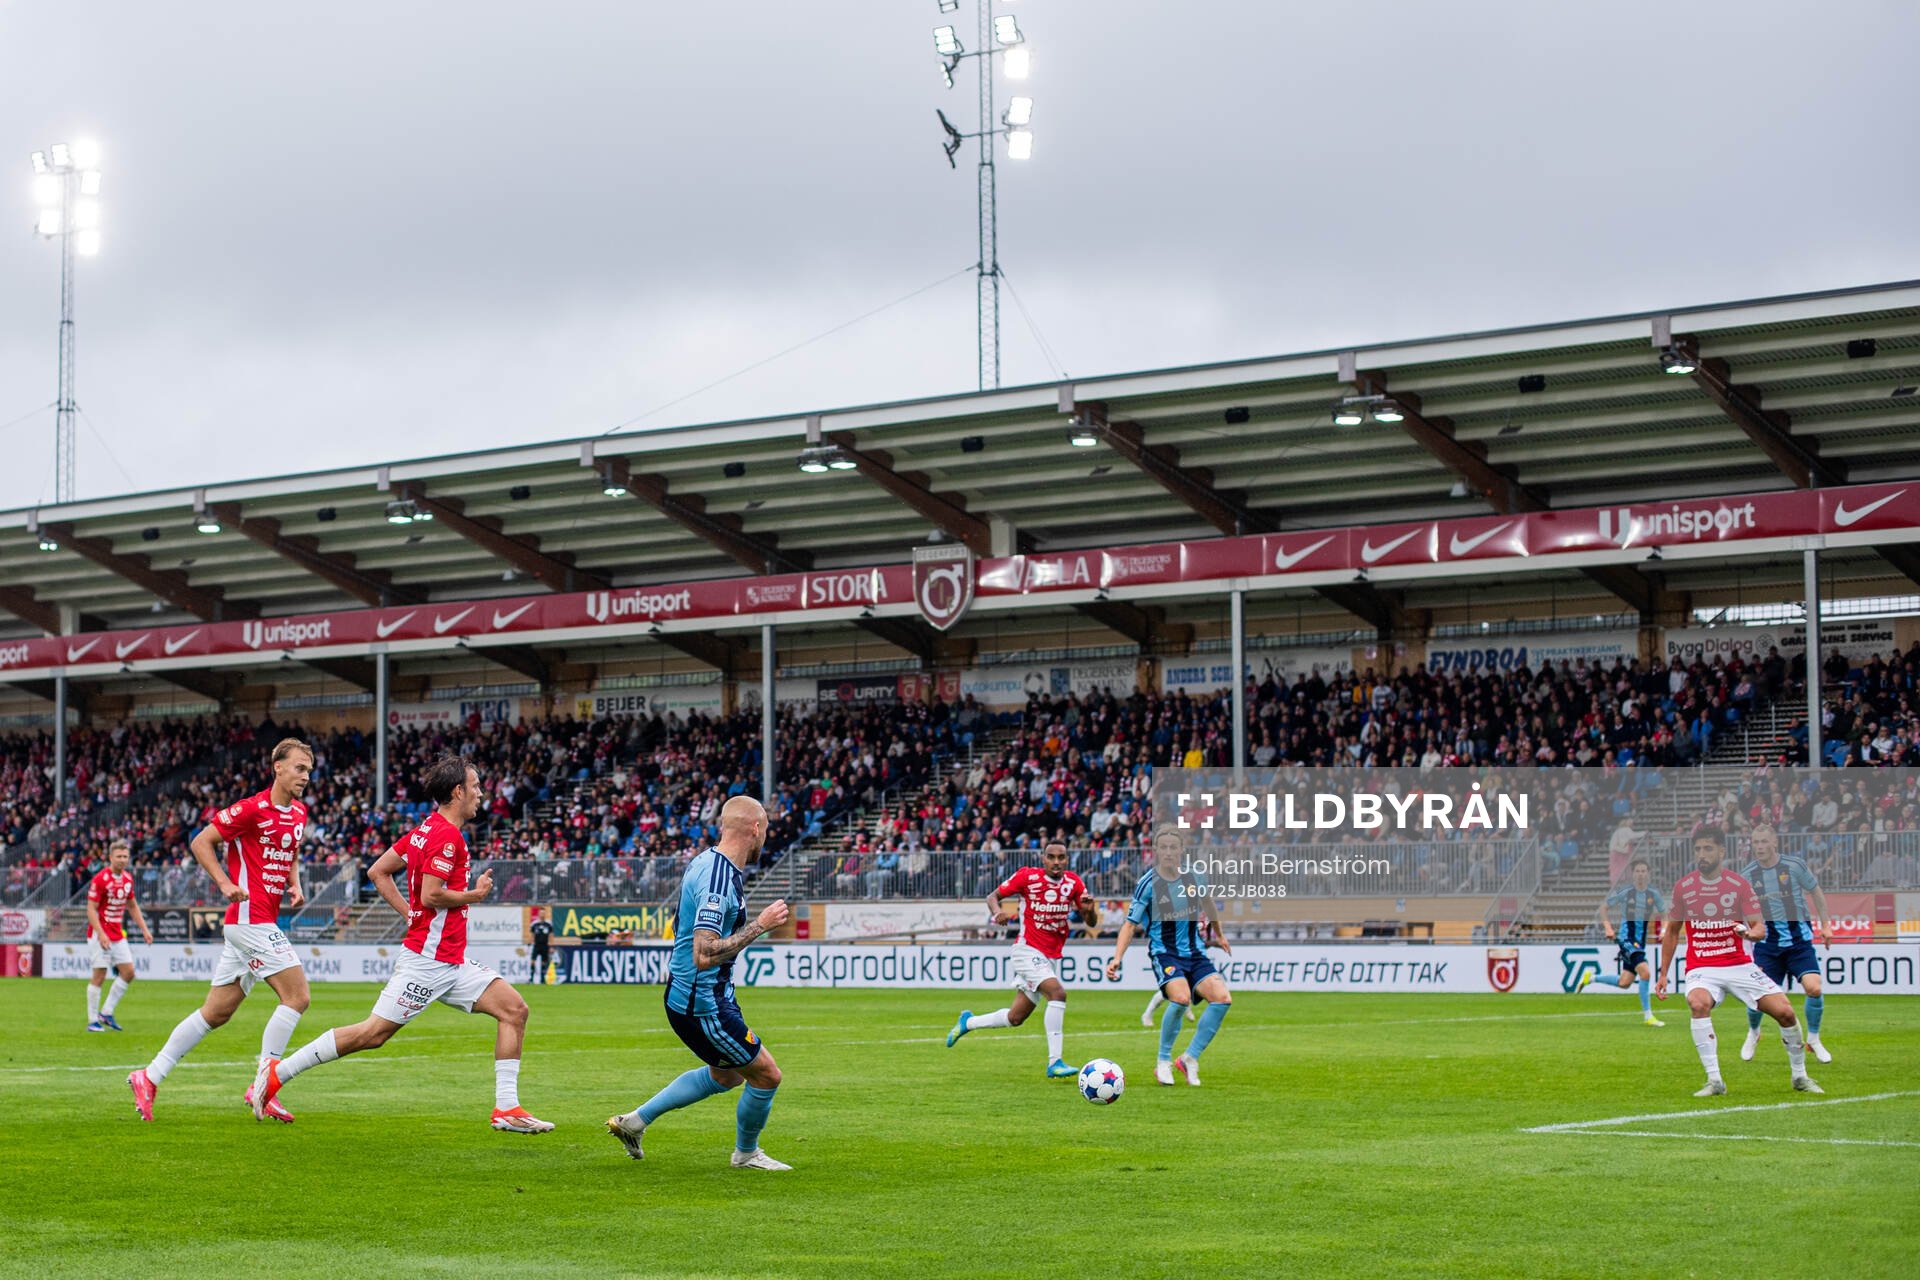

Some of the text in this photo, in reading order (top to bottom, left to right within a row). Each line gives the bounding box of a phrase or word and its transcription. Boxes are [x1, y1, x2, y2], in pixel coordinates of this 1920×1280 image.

[1636, 501, 1756, 538] unisport
[612, 589, 691, 618] unisport
[264, 619, 331, 645] unisport
[1851, 632, 1893, 643] SERVICE
[1668, 637, 1753, 657] ByggDialog
[1073, 663, 1134, 680] DEGERFORS
[1167, 667, 1206, 684] ANDERS
[596, 696, 646, 713] BEIJER
[1030, 901, 1069, 912] Helmia
[562, 907, 669, 937] Assembli
[699, 910, 724, 922] UNIBET
[474, 920, 521, 932] Munkfors
[52, 957, 91, 972] EKMAN
[170, 957, 213, 973] EKMAN
[571, 949, 672, 984] ALLSVENSK
[1219, 957, 1449, 983] KERHET FÖR DITT TAK
[406, 982, 434, 998] CEOS
